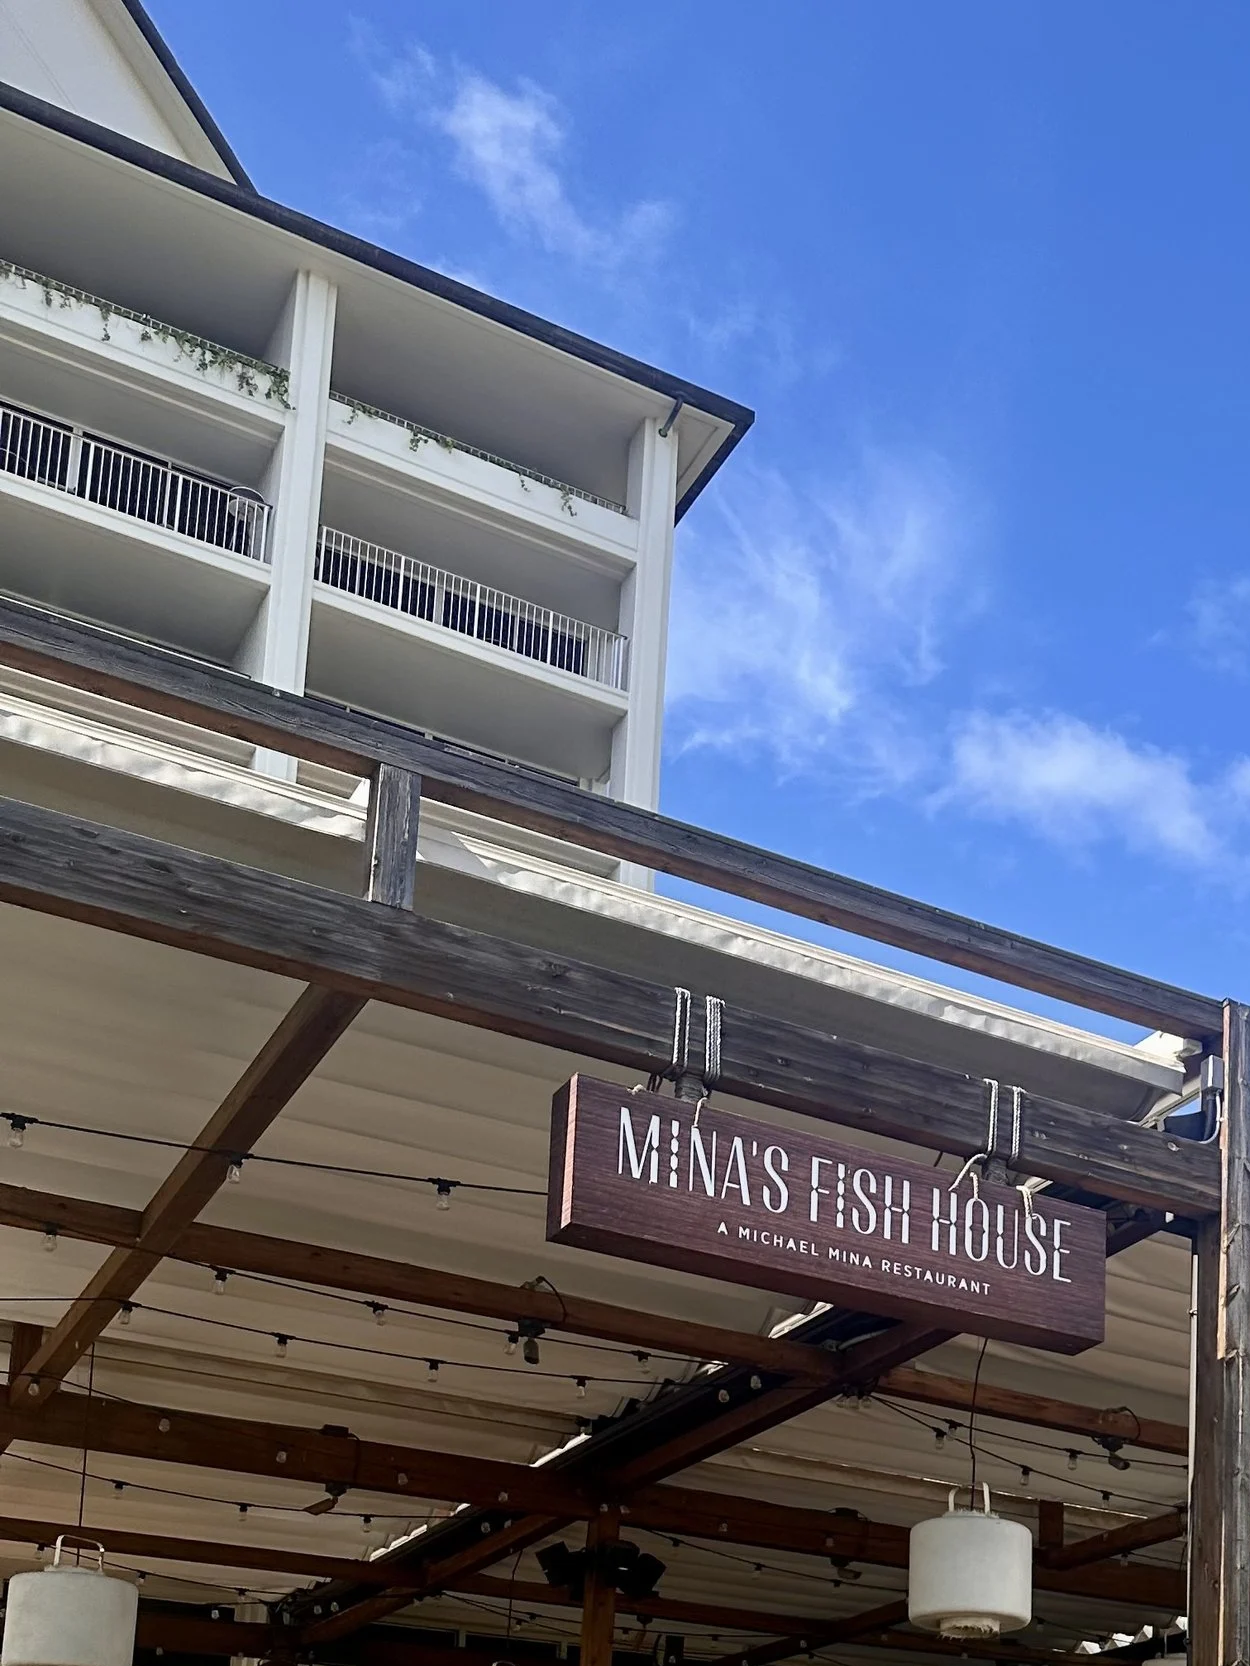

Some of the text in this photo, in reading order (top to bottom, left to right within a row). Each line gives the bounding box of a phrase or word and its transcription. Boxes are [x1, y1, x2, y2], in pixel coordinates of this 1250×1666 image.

[618, 1106, 1073, 1283] MINA'S FISH HOUSE
[717, 1221, 991, 1296] A MICHAEL MINA RESTAURANT
